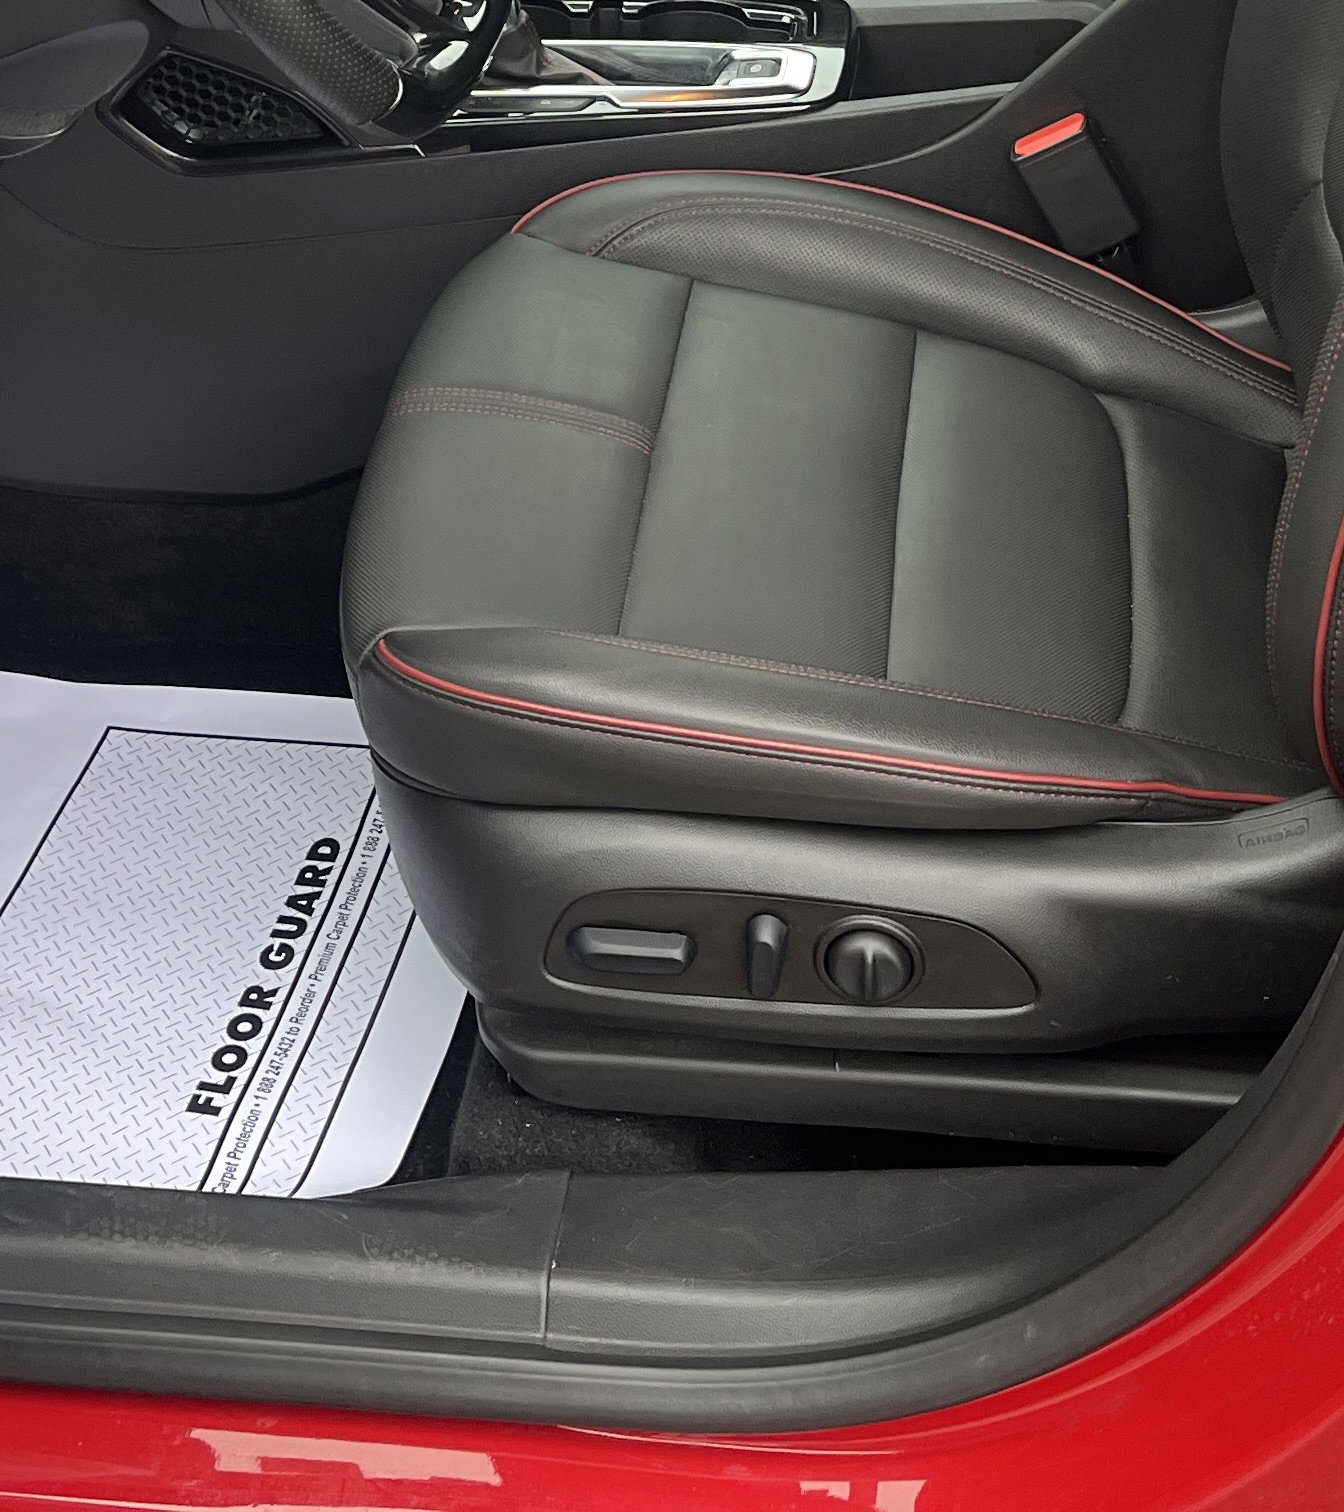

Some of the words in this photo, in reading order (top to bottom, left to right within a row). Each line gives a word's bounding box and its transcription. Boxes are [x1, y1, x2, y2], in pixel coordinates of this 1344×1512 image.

[338, 866, 369, 911] Protection
[326, 911, 350, 941] Carpet
[185, 984, 282, 1118] FLOOR
[258, 837, 342, 971] GUARD
[308, 942, 338, 982] Premium
[288, 987, 318, 1026] Reorder
[284, 1025, 301, 1037] to
[226, 1108, 263, 1162] Protection
